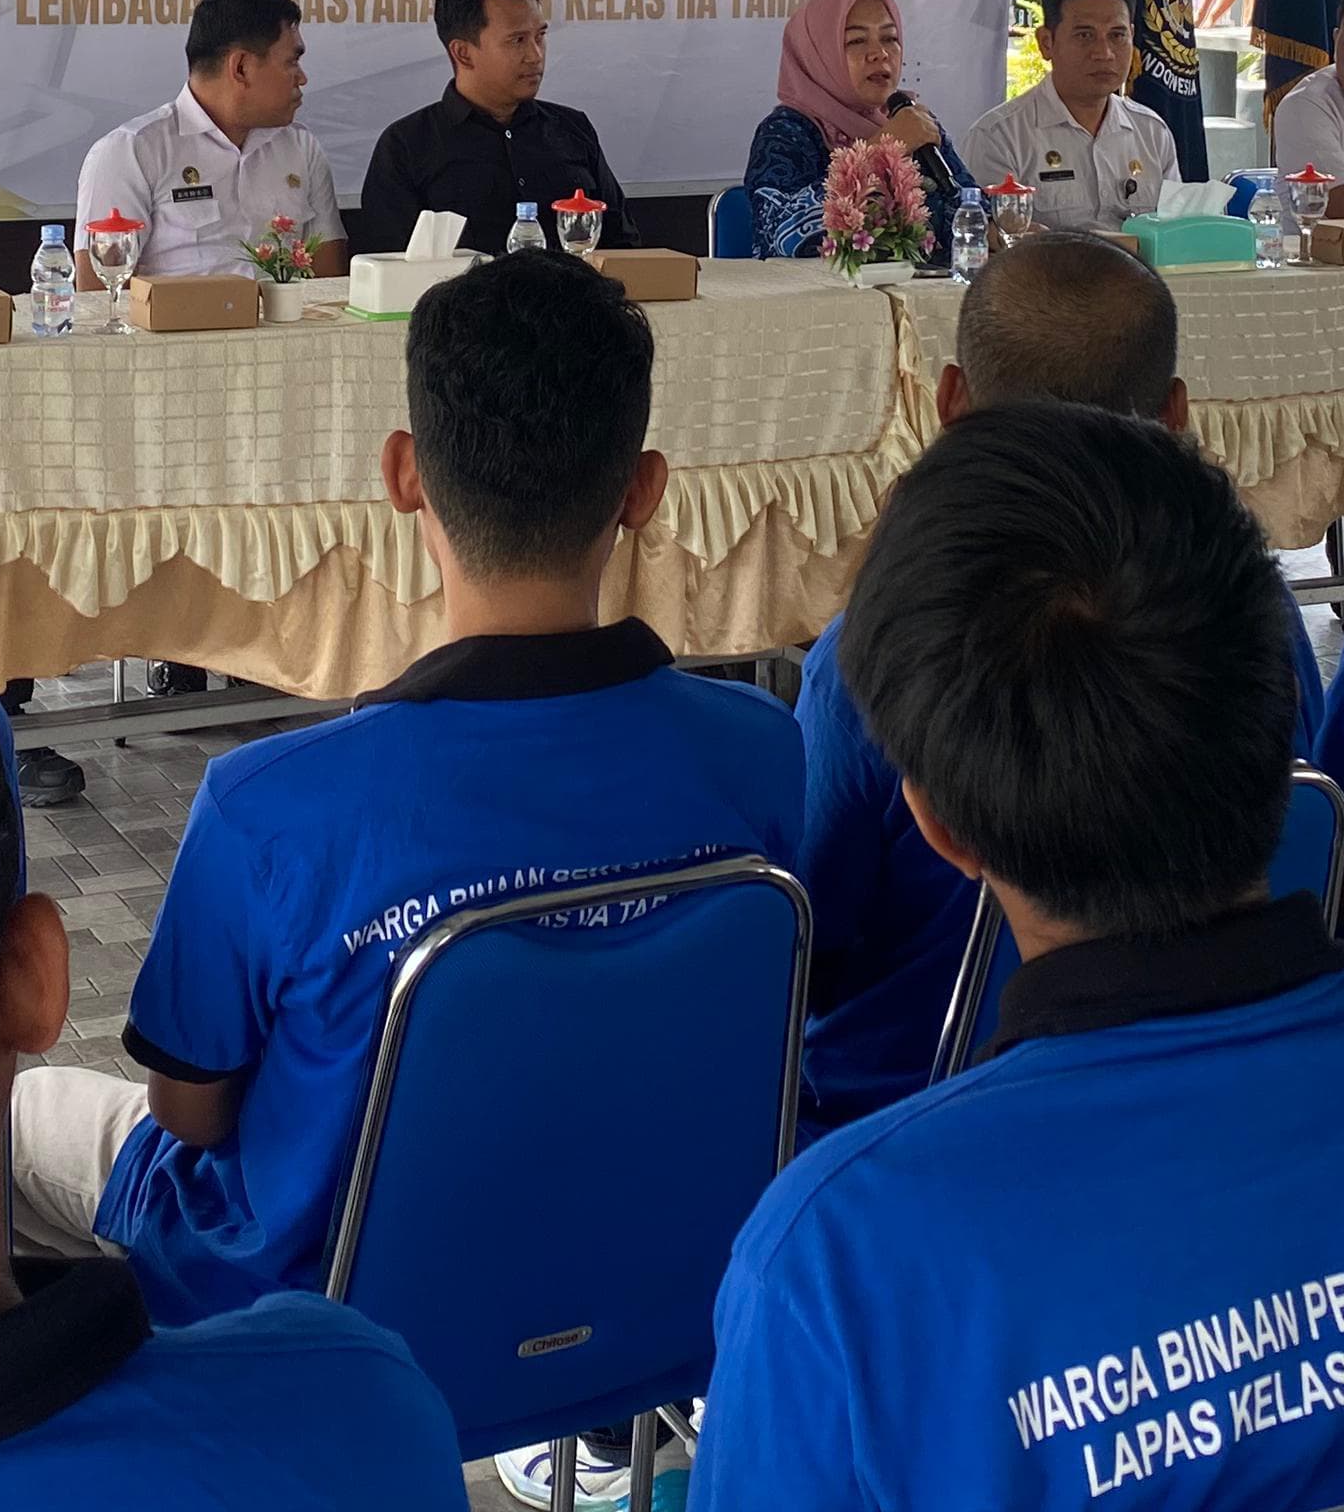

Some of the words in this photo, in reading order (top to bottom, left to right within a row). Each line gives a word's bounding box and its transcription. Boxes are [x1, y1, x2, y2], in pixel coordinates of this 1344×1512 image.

[343, 894, 441, 956] WARGA
[1007, 1345, 1158, 1450] WARGA
[1157, 1290, 1300, 1392] BINAAN
[1082, 1399, 1223, 1498] LAPAS
